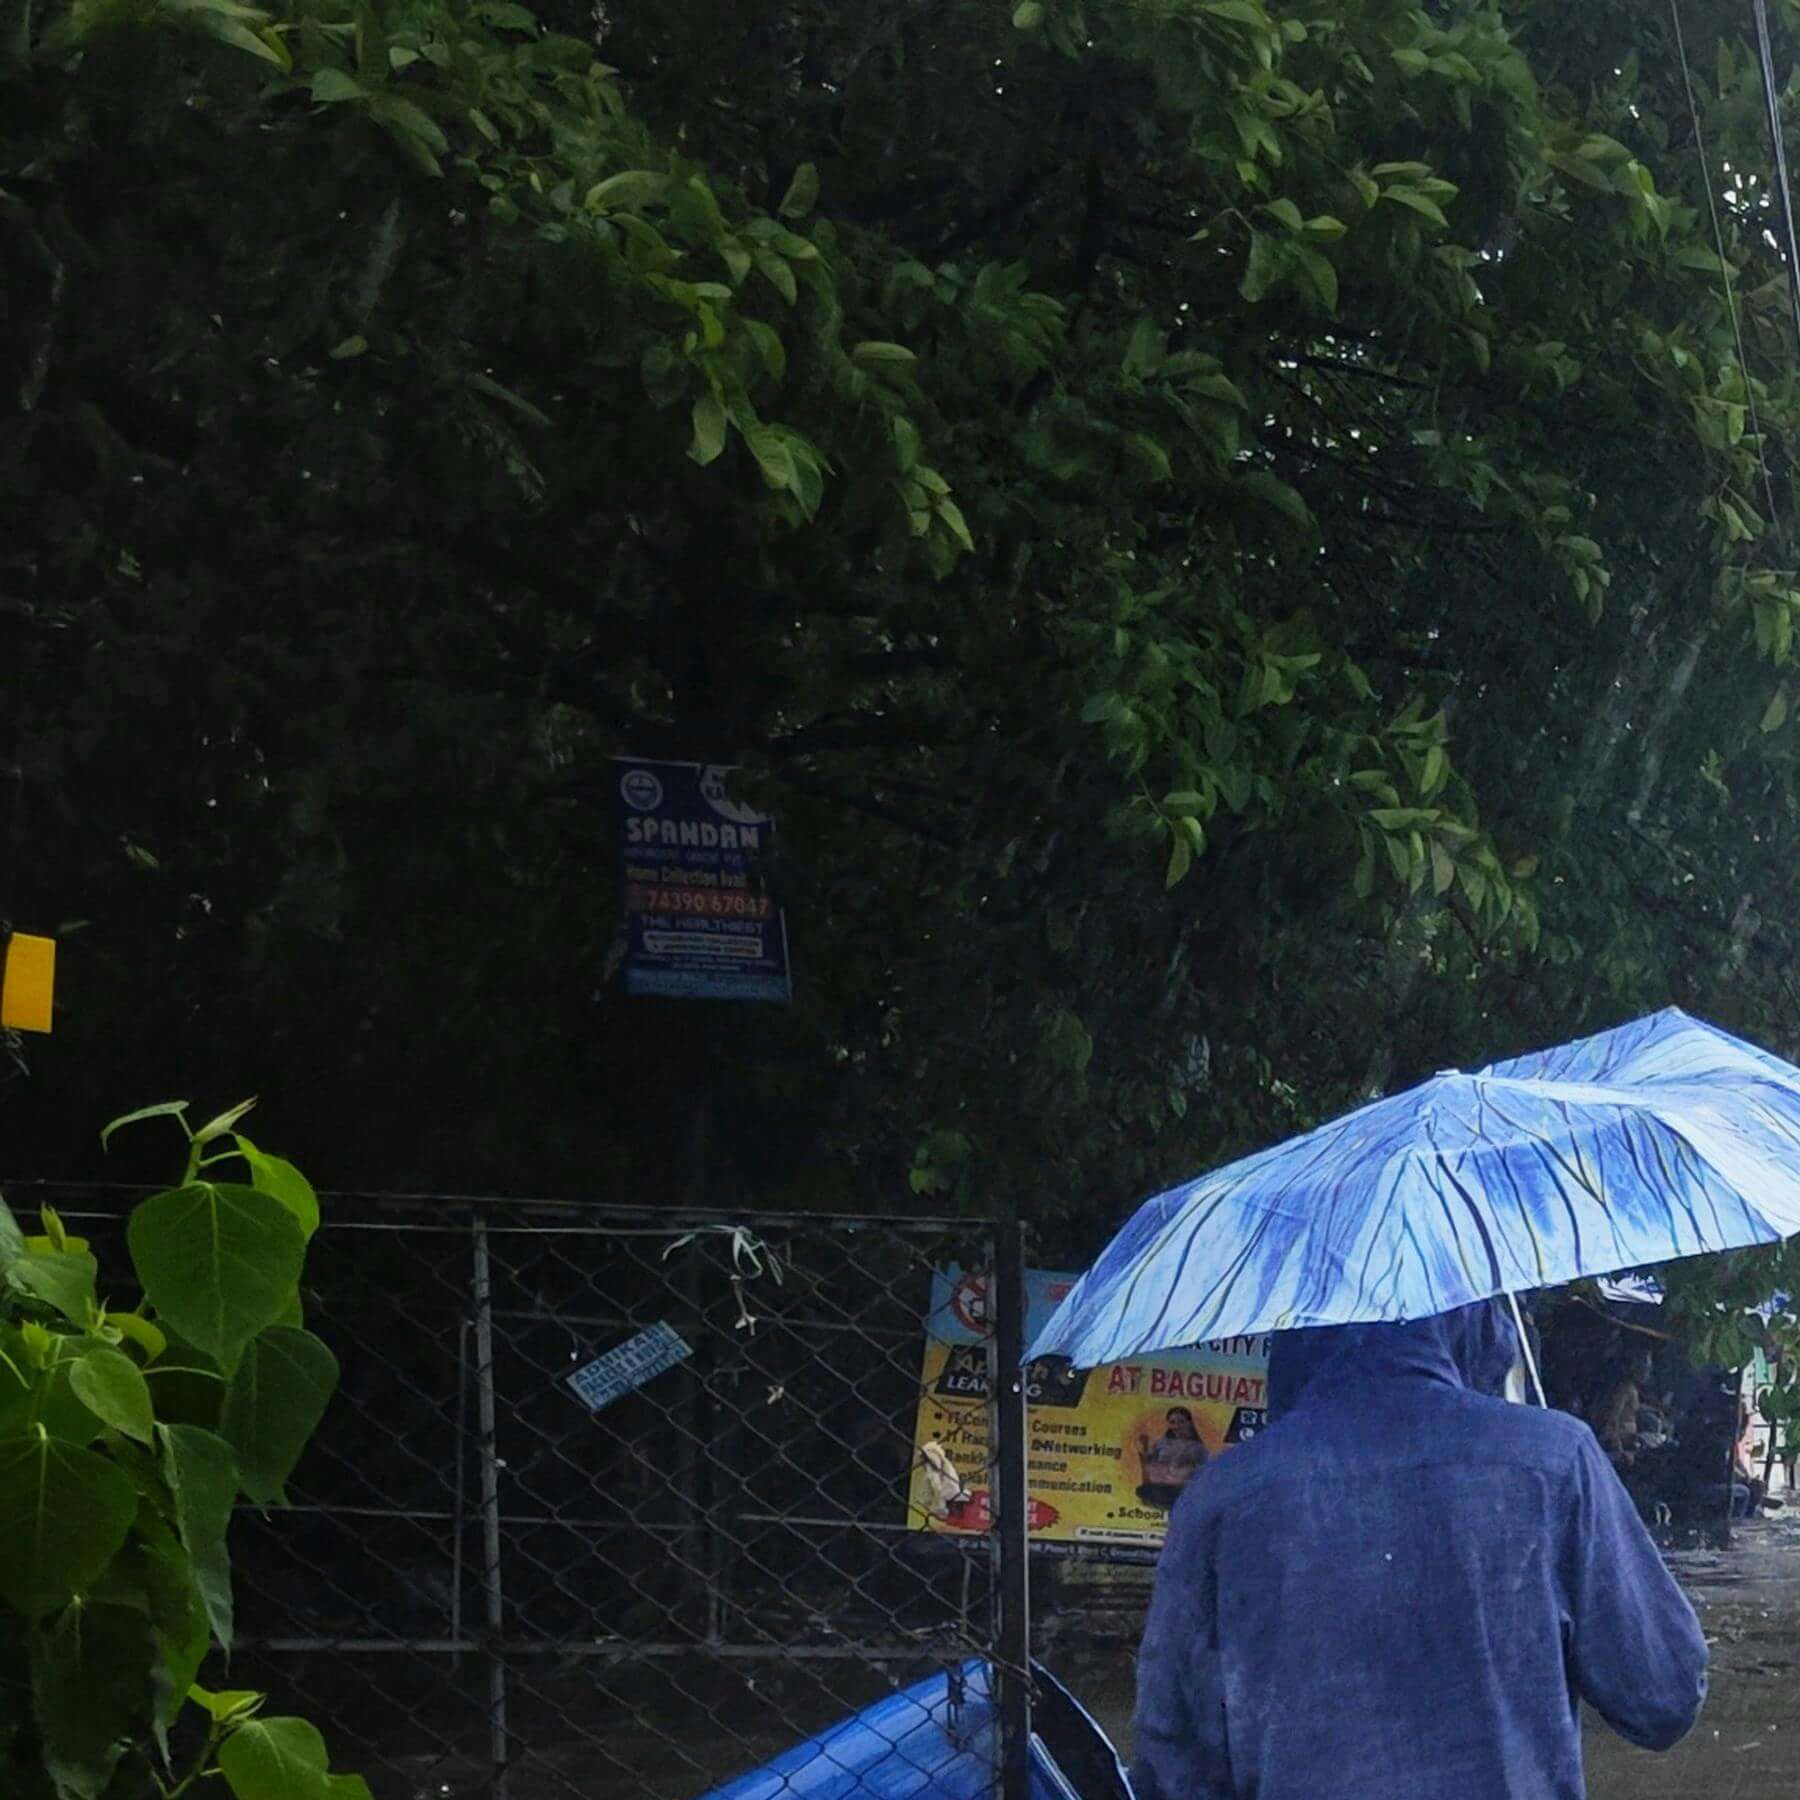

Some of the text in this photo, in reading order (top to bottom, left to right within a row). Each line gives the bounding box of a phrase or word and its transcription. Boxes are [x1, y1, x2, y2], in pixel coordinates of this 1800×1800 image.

[626, 816, 759, 848] SPANDAN
[1108, 1366, 1264, 1404] AT BAGUIAT
[1031, 1420, 1087, 1437] Courses
[1118, 1507, 1164, 1521] School
